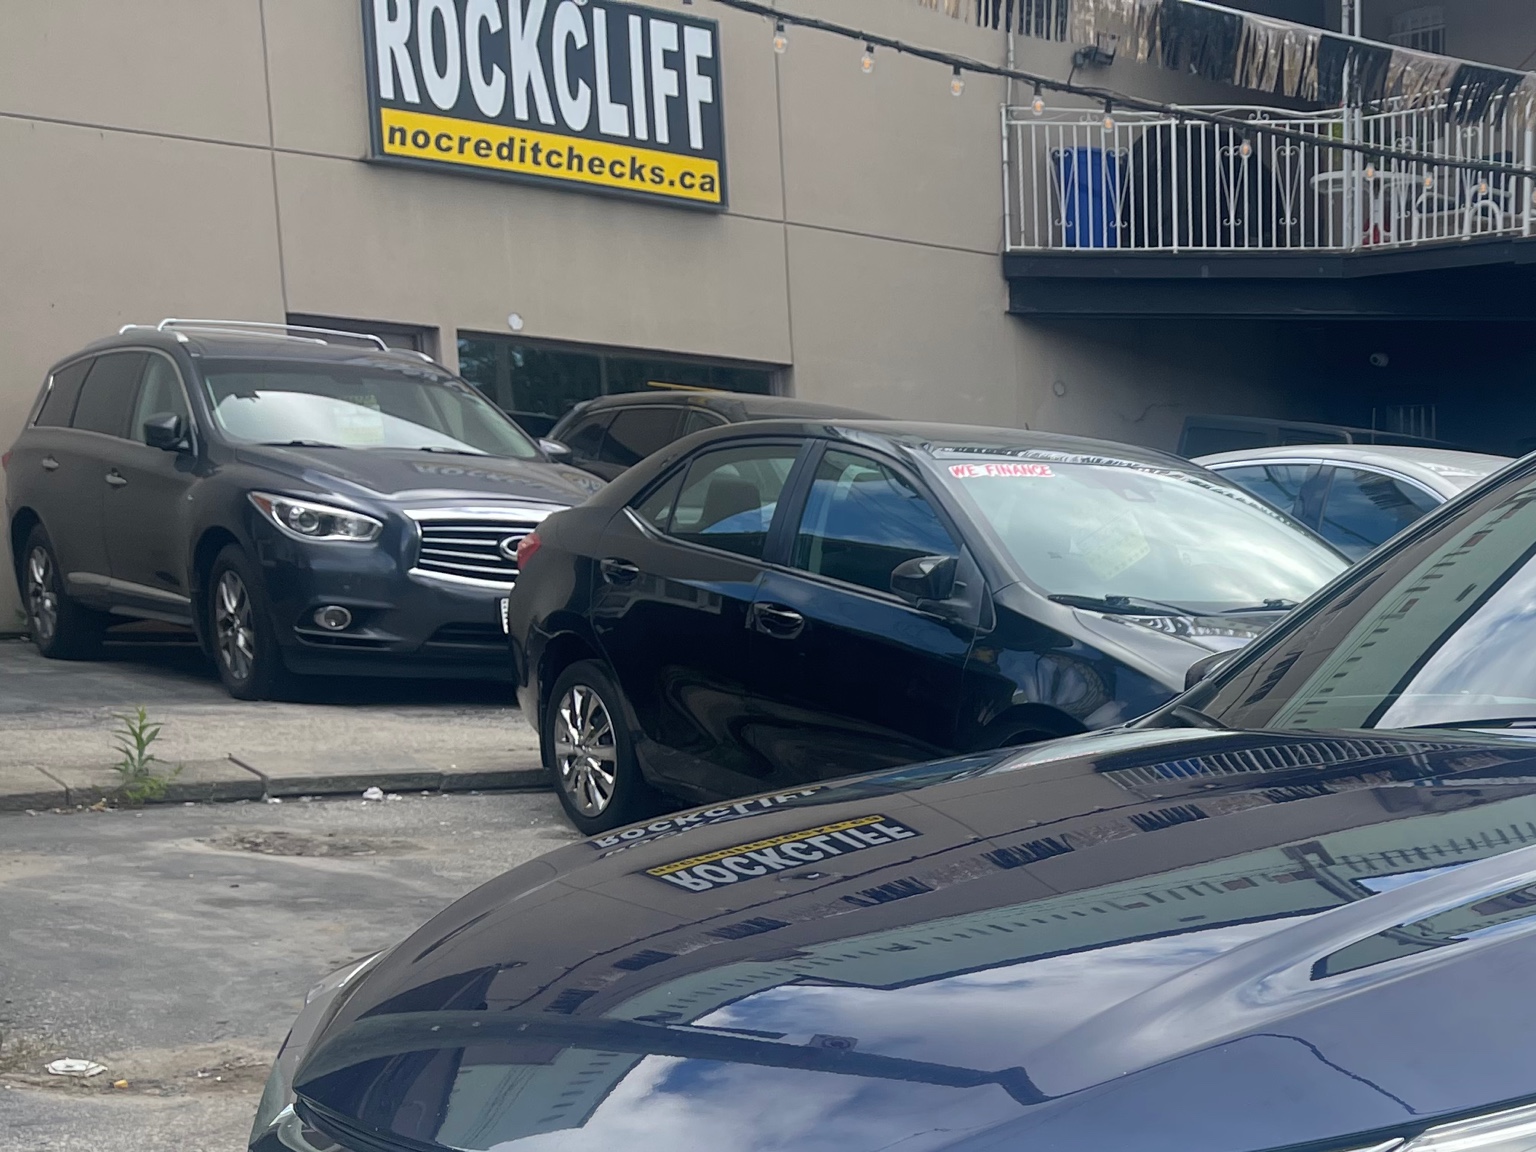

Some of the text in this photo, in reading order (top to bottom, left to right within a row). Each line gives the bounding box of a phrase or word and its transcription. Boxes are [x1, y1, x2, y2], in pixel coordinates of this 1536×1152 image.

[374, 0, 713, 151] ROCKCLIFF
[388, 124, 715, 193] nocreditchecks.ca
[951, 464, 1053, 477] WE FINANCE
